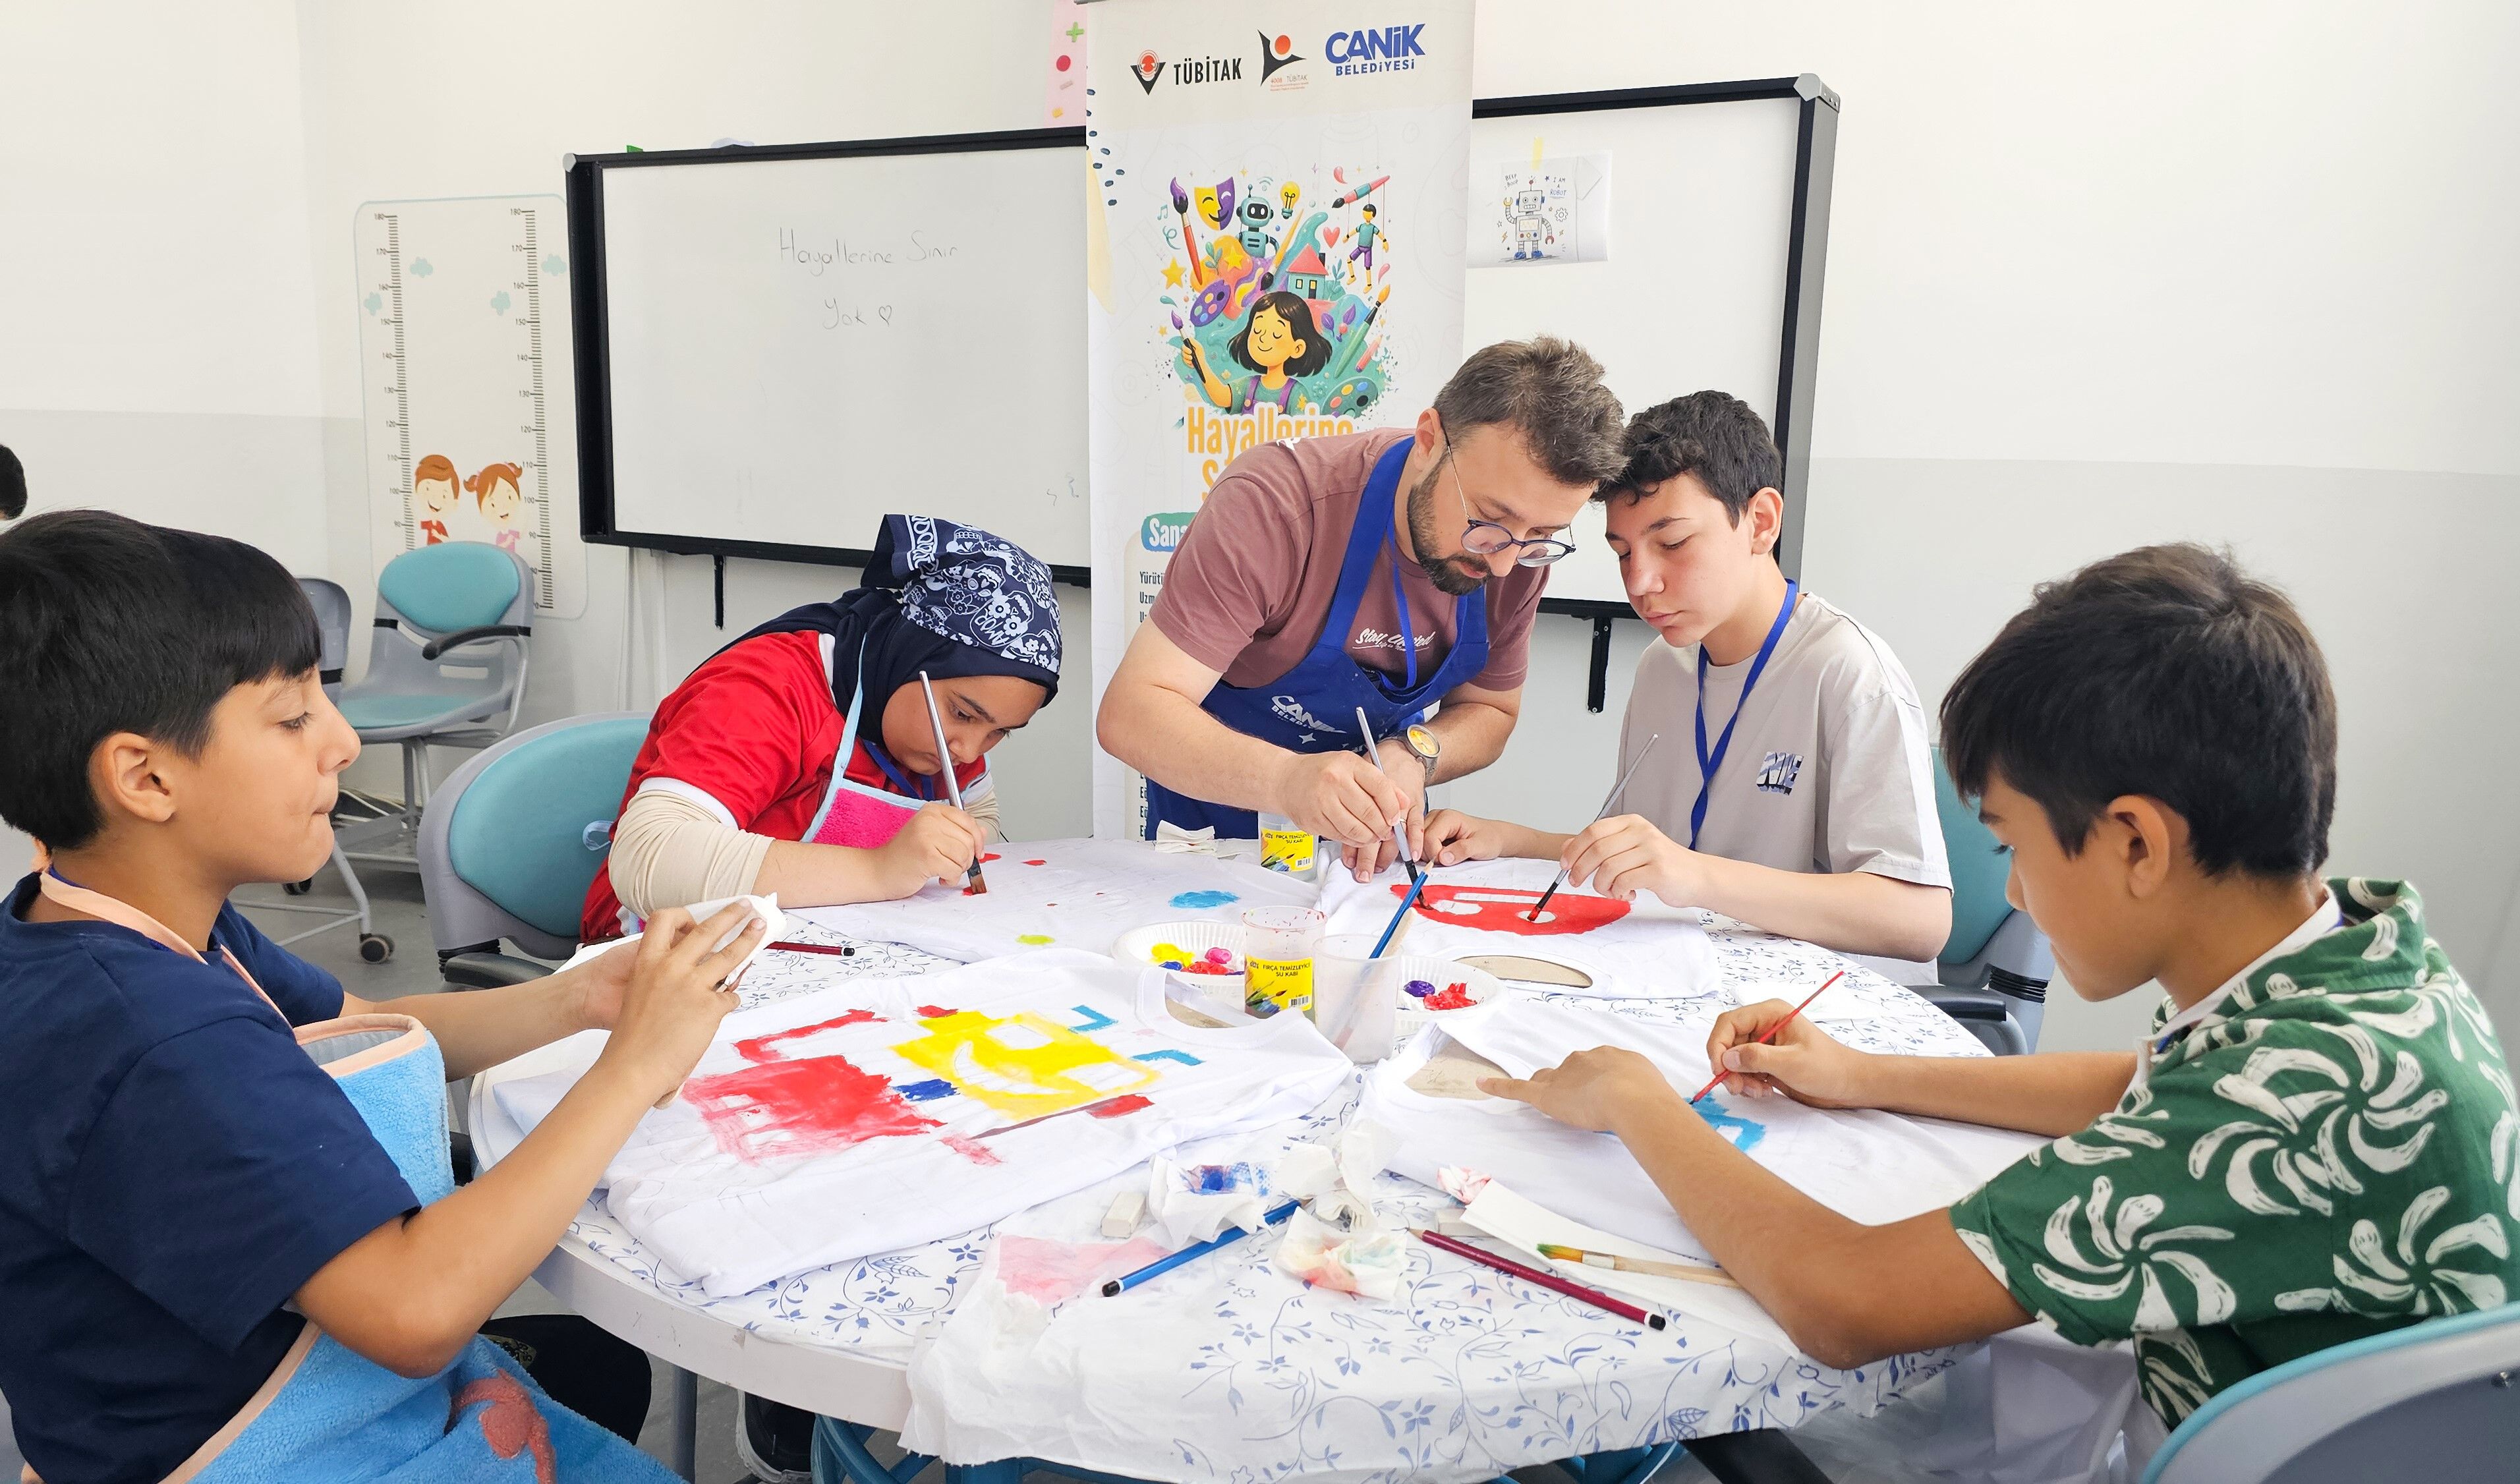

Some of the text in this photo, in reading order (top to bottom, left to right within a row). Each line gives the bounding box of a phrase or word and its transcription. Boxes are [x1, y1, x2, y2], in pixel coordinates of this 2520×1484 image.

[1174, 55, 1242, 85] TÜBİTAK
[780, 226, 894, 277] Hayallerine
[524, 496, 535, 504] 100
[1355, 627, 1389, 645] Stay
[1271, 695, 1347, 733] CAN
